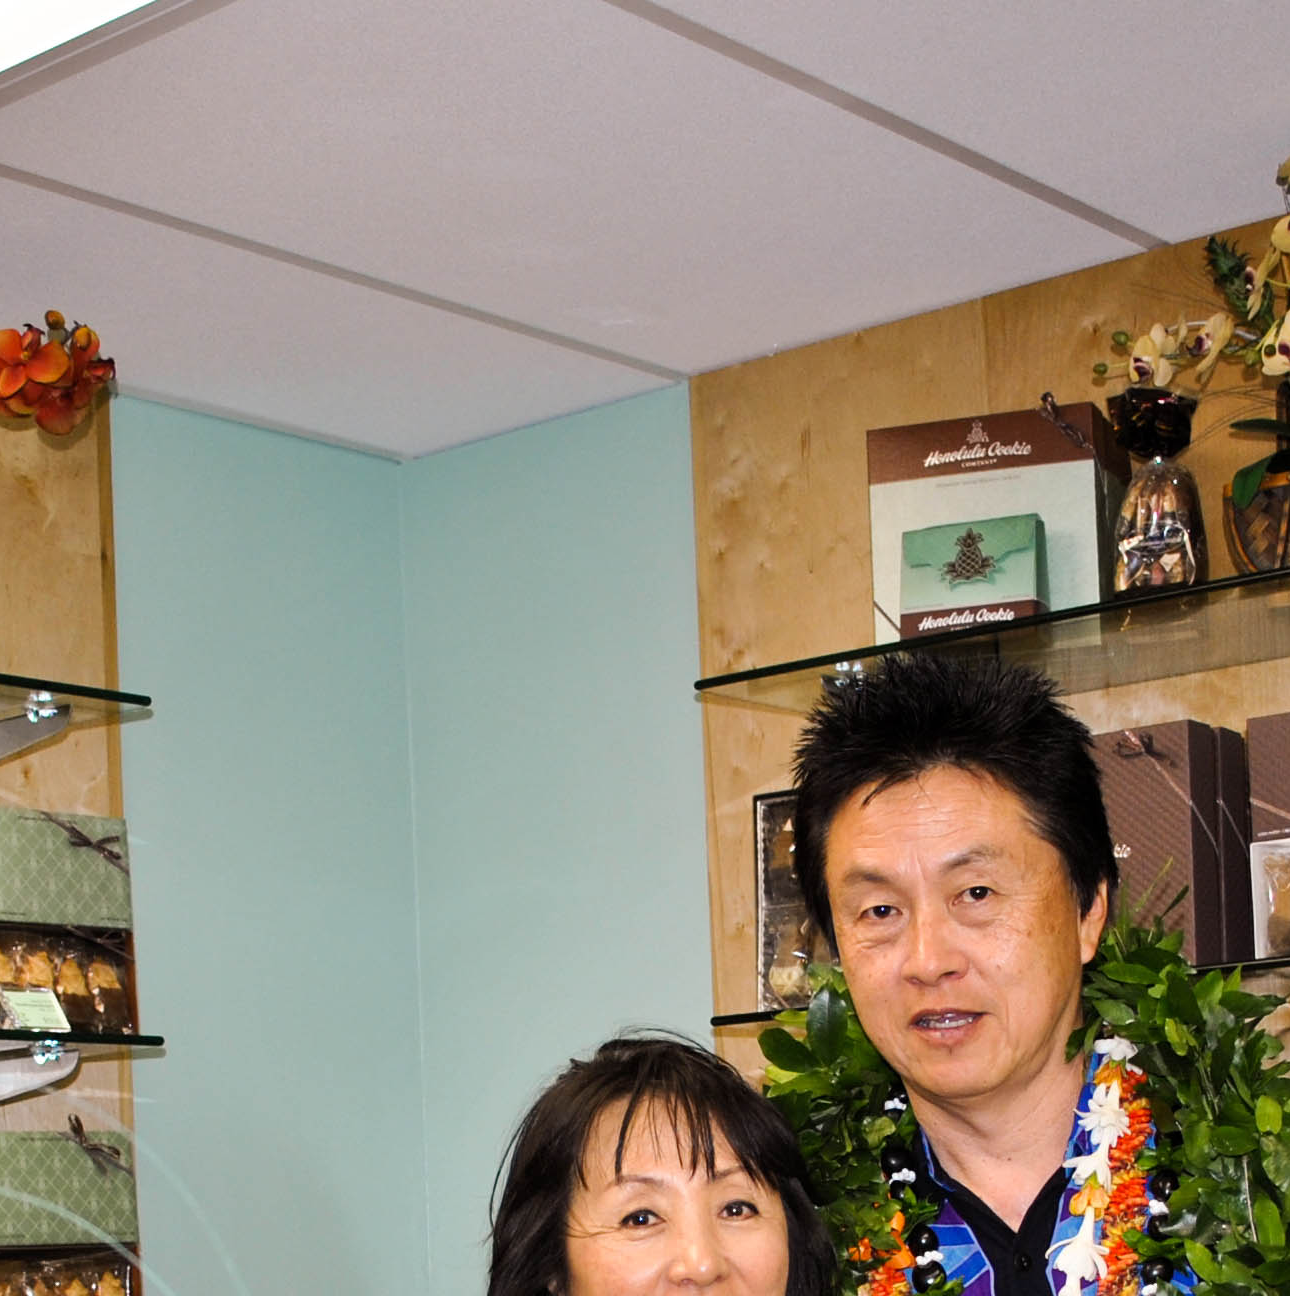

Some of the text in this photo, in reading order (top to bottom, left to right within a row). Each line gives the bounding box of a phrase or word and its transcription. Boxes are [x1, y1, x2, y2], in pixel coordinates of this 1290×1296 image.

[923, 441, 1032, 468] Honolulu Cookie
[917, 607, 1015, 631] Honolulu Cookie
